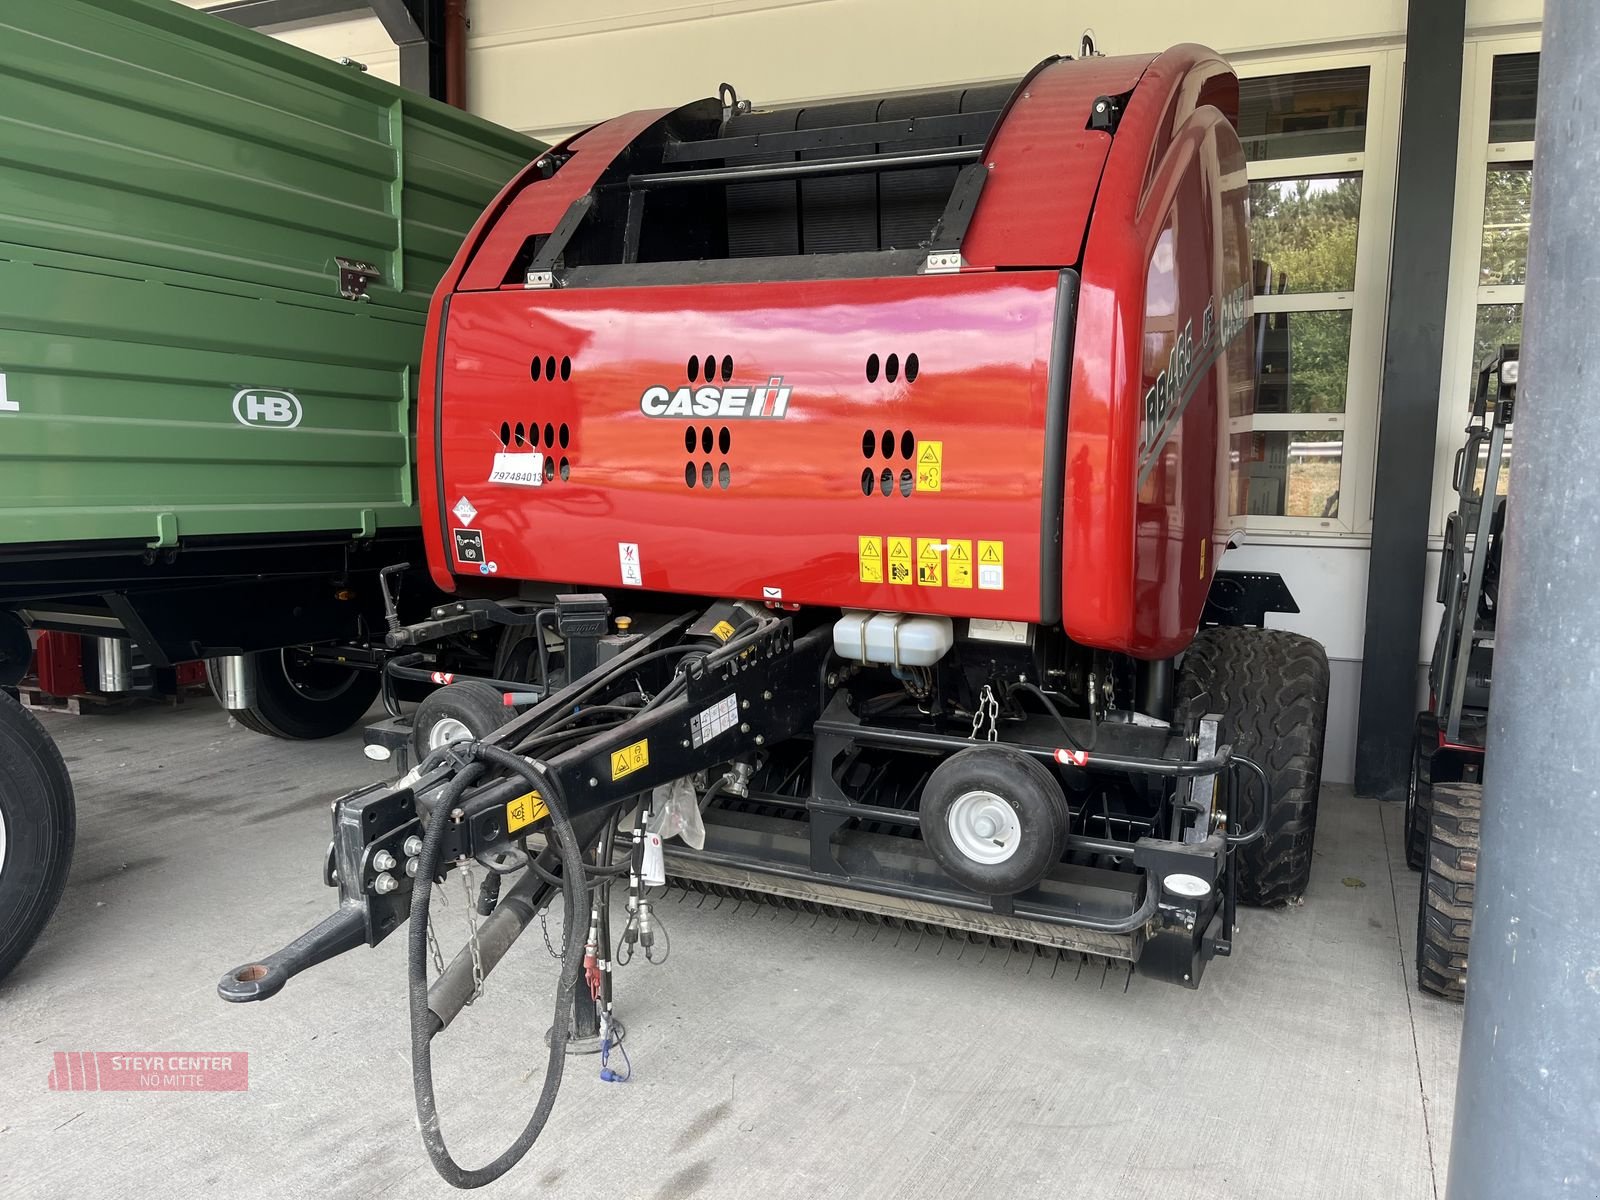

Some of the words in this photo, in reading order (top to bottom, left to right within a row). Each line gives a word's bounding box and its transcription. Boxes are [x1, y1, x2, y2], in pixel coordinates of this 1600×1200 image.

[246, 394, 293, 422] HB
[641, 386, 750, 417] CASE
[493, 471, 543, 482] 797484013
